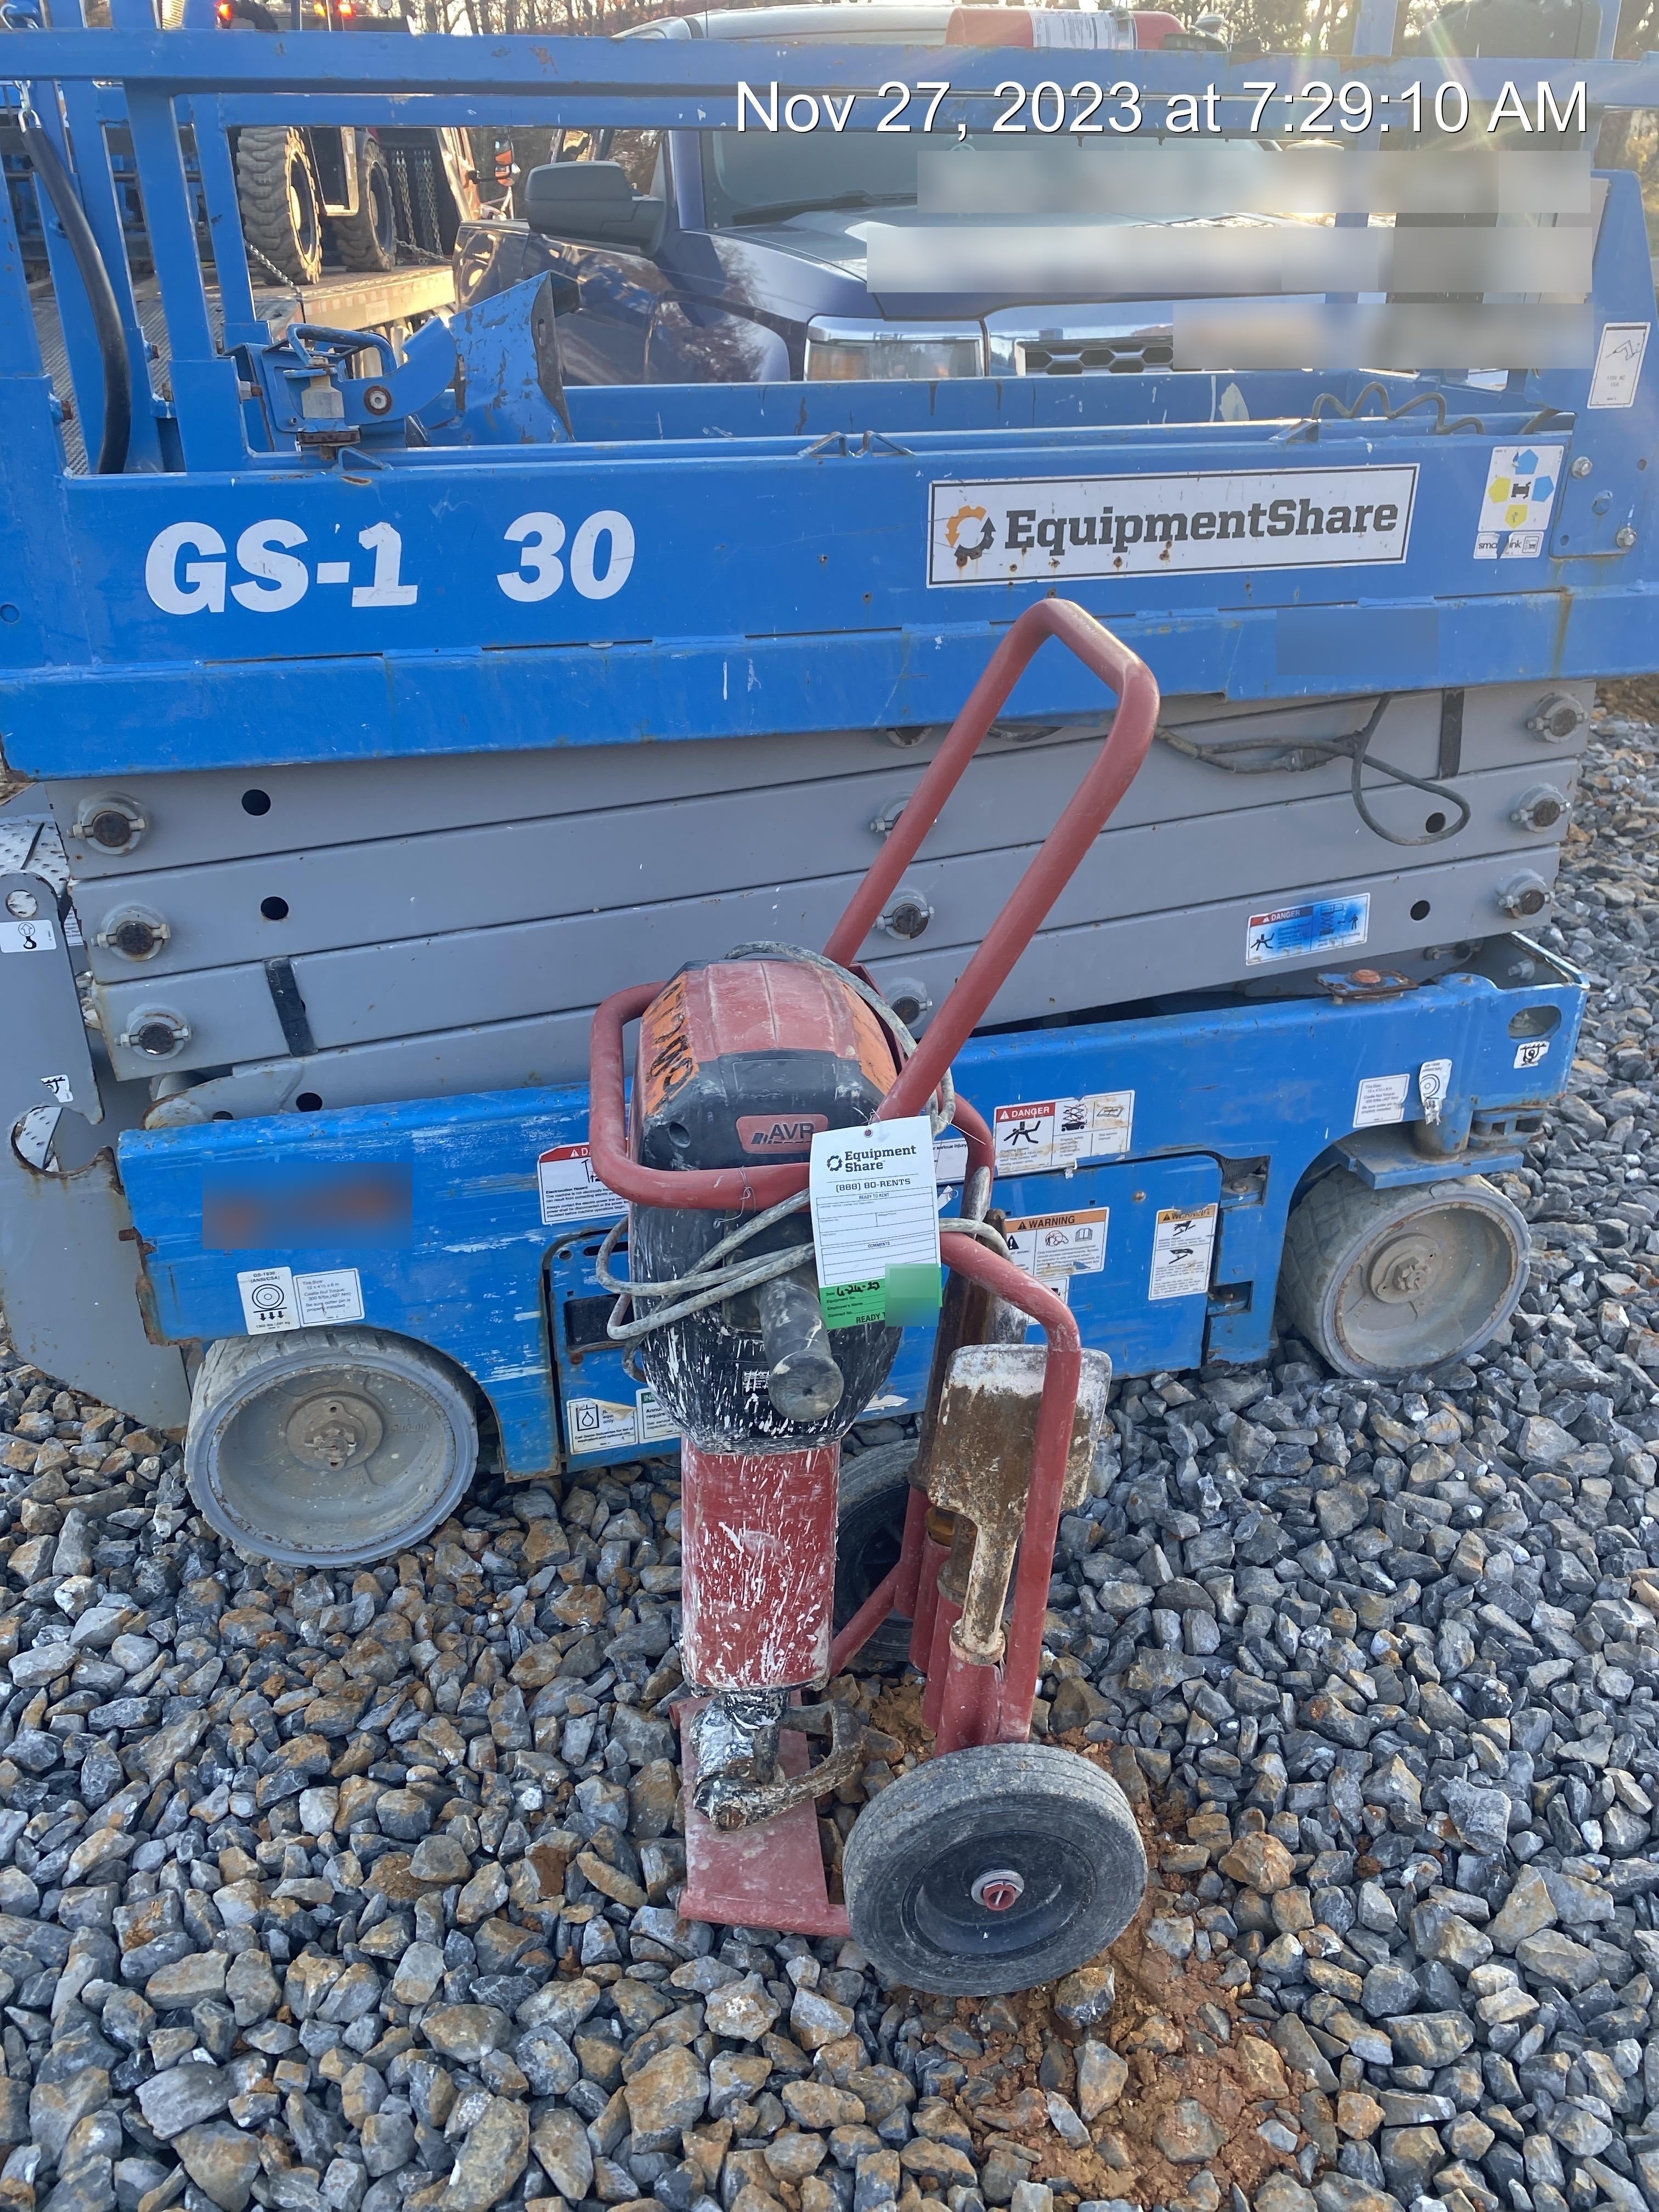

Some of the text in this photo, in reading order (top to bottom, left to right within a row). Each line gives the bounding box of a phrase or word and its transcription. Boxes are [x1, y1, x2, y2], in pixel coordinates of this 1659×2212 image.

[1005, 498, 1398, 556] EquipmentShare
[145, 510, 636, 615] GS-1 30
[1271, 910, 1300, 921] DANGER
[1012, 1107, 1049, 1118] DANGER
[769, 1123, 814, 1139] AVR
[845, 1146, 916, 1161] Equipment
[845, 1162, 883, 1172] Share
[836, 1178, 911, 1192] (888) 80-RENTS
[1029, 1216, 1075, 1228] WARNING
[856, 1312, 880, 1324] READY
